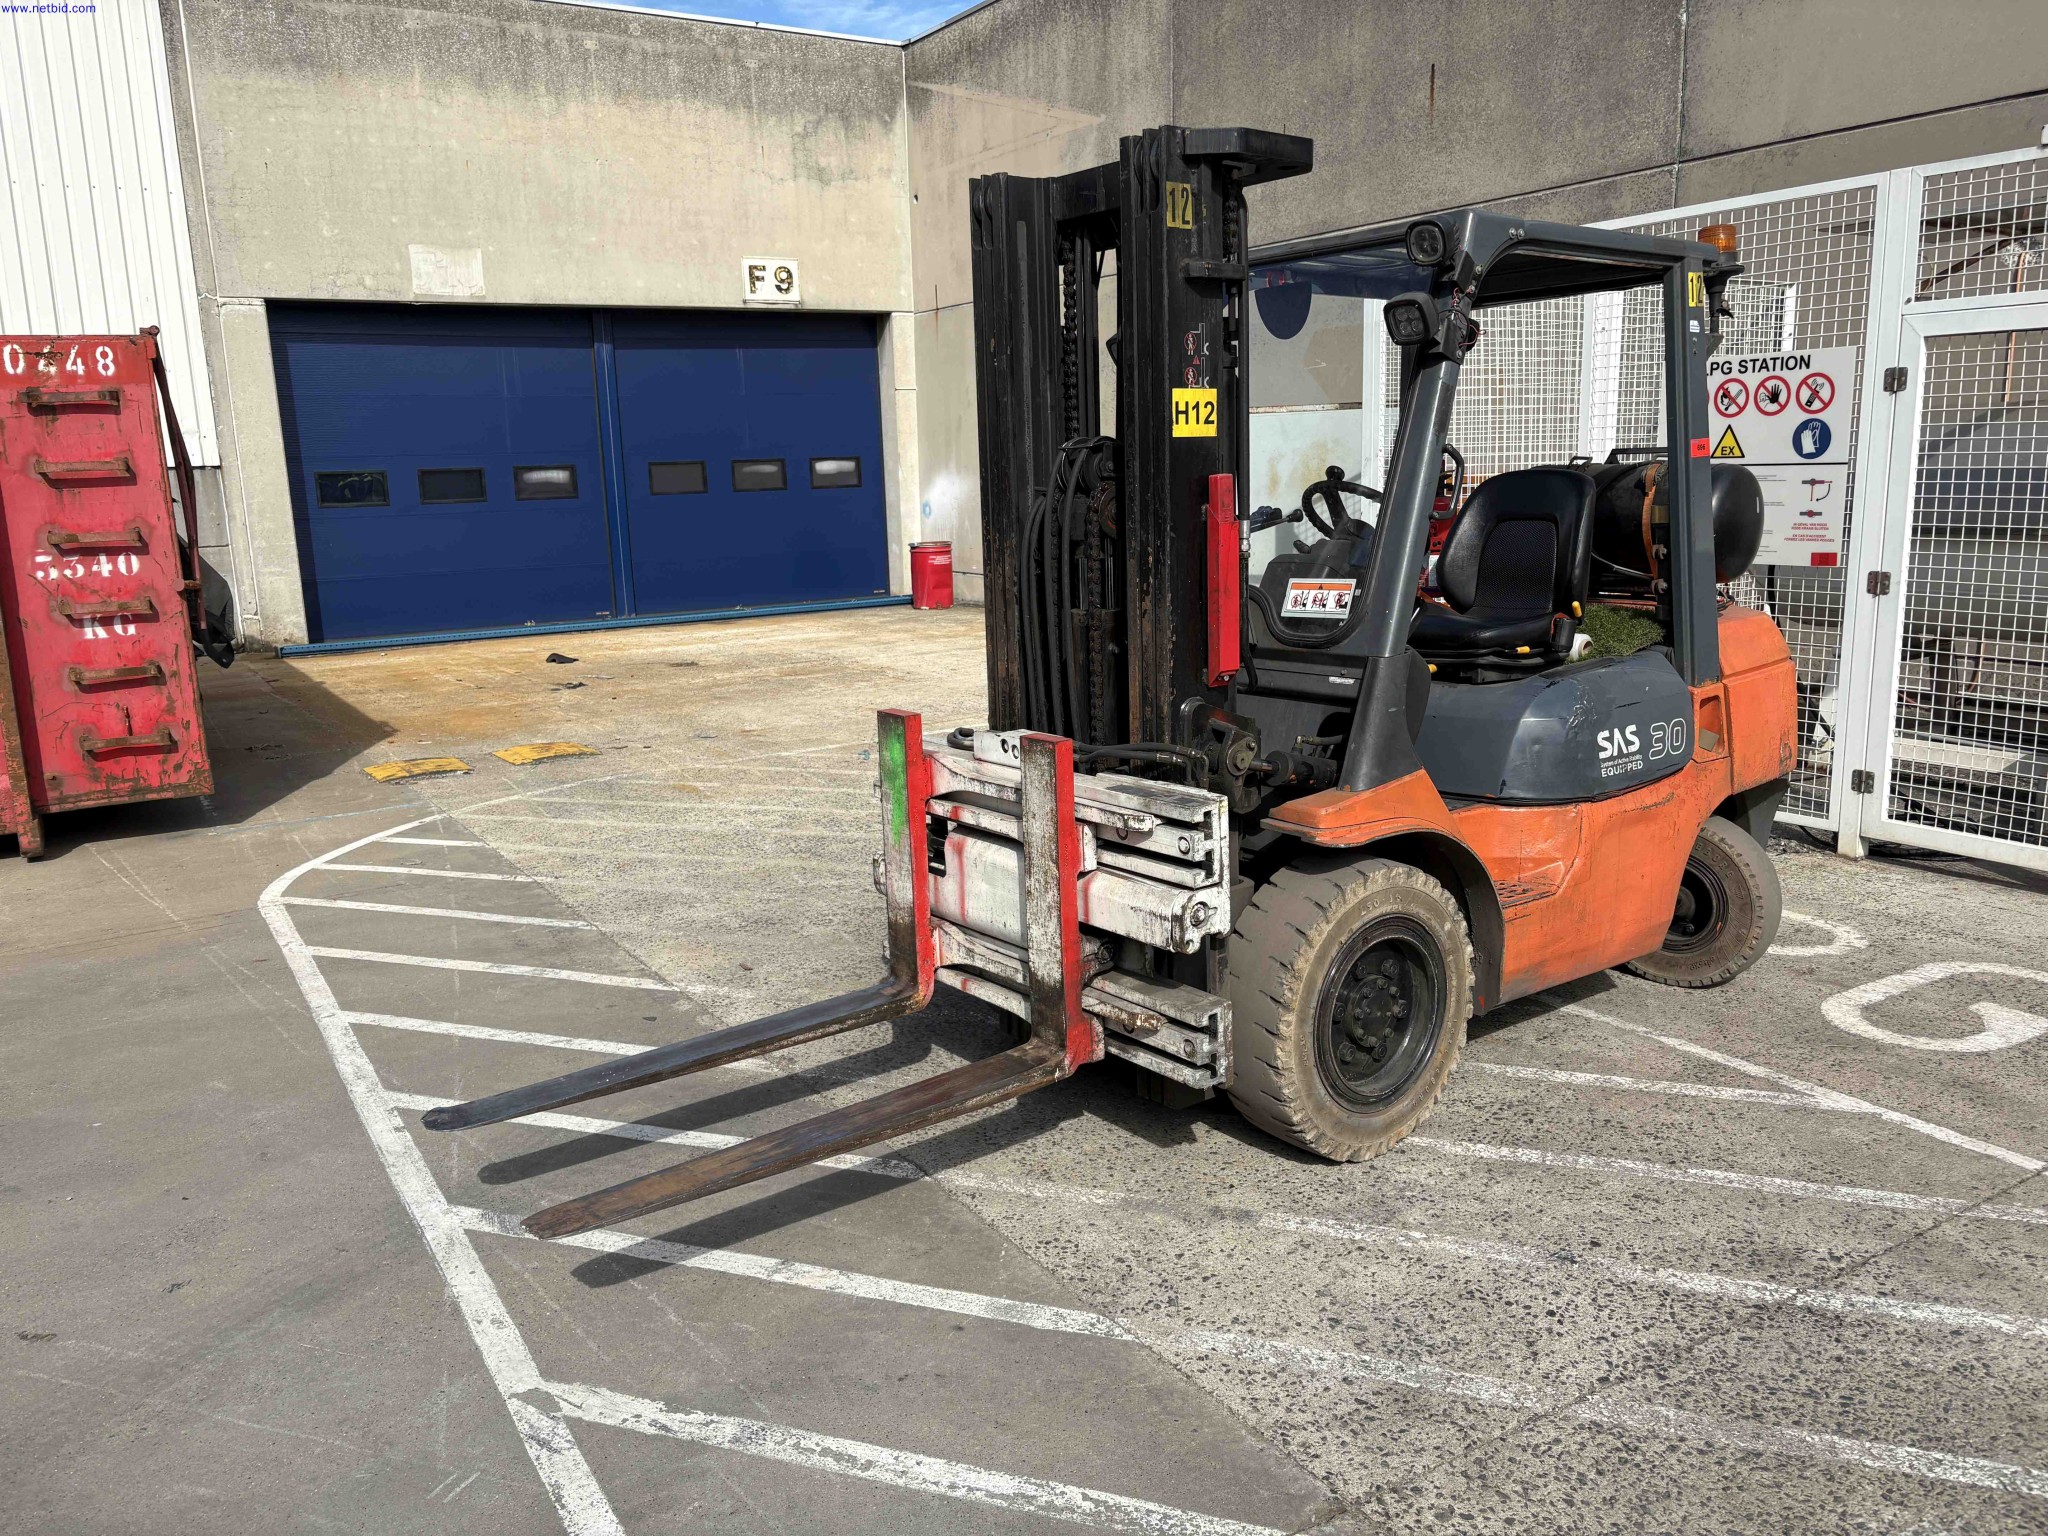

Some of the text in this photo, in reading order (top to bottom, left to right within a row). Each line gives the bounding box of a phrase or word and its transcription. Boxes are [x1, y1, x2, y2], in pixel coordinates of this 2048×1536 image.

[1169, 186, 1191, 225] 12
[1690, 274, 1703, 304] 12
[1706, 354, 1811, 376] PG STATION
[1174, 401, 1215, 426] H12
[1720, 446, 1735, 456] EX
[1597, 724, 1640, 759] SAS
[1649, 718, 1686, 760] 30
[1601, 760, 1643, 778] EQUIPPED
